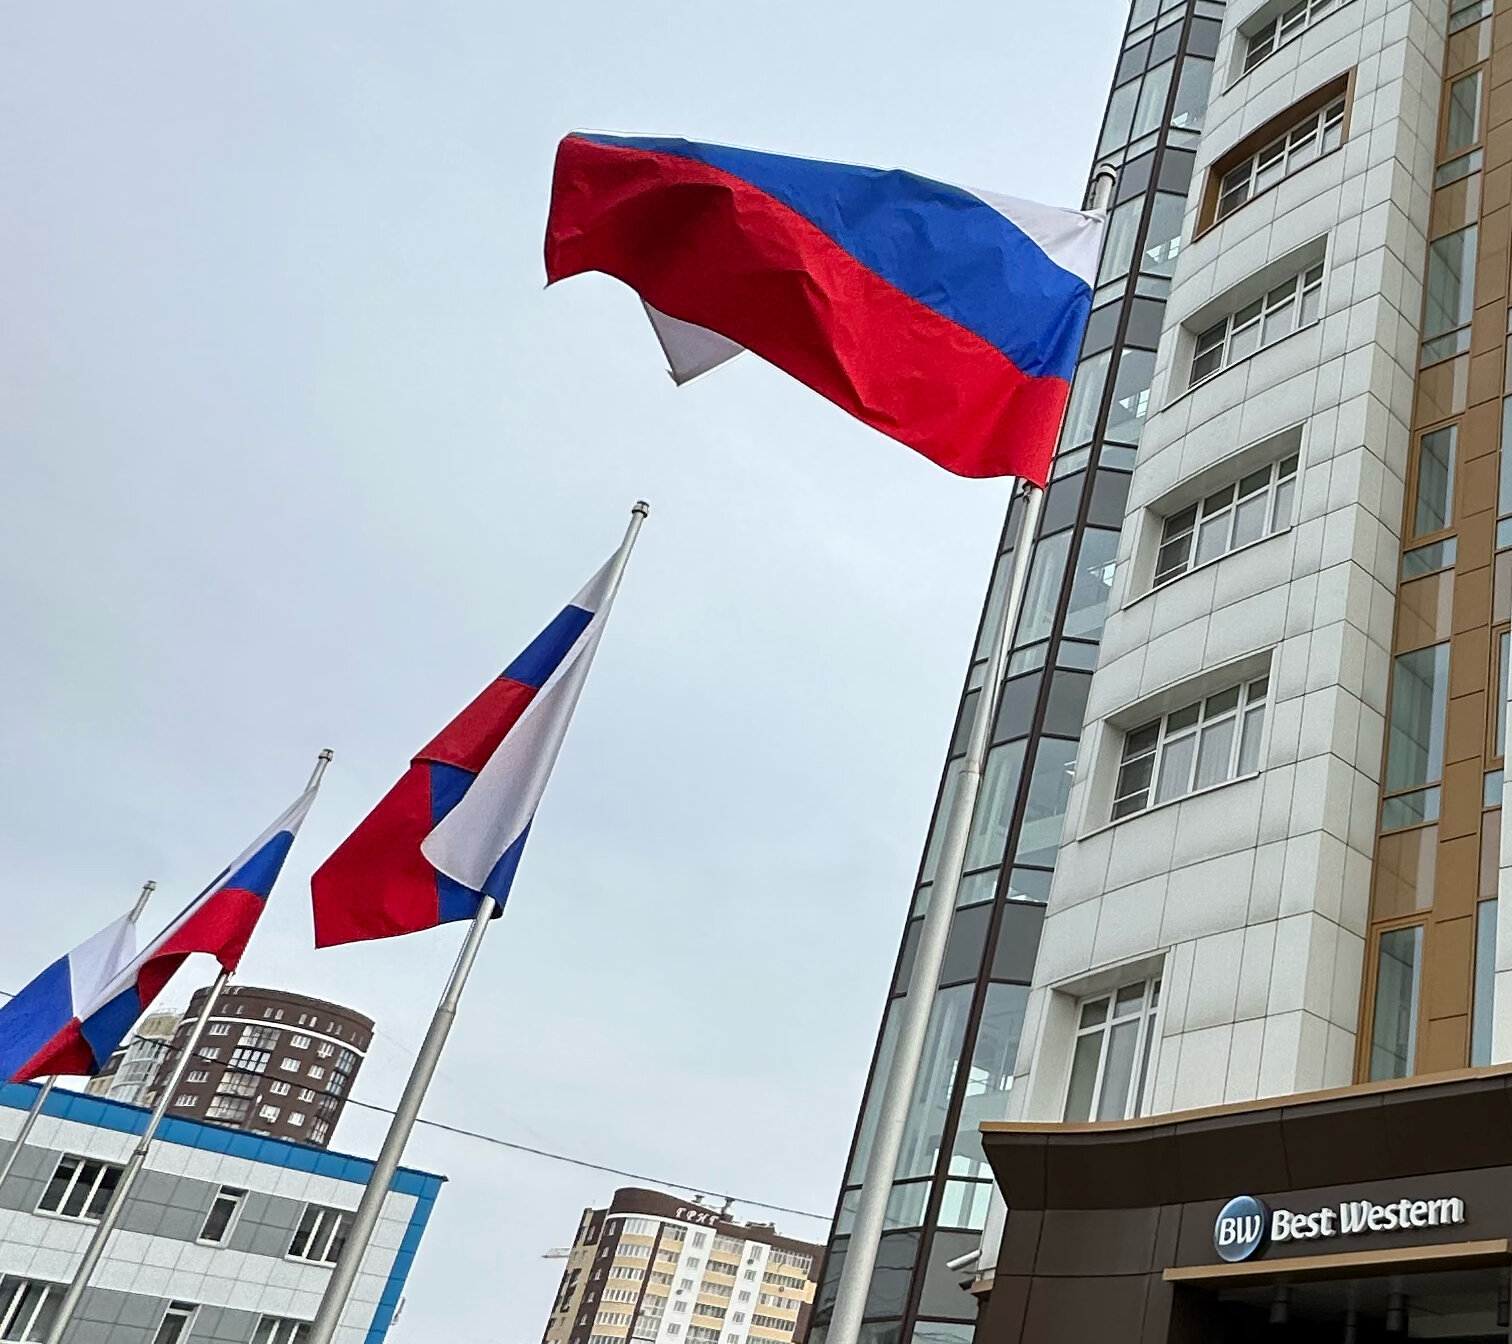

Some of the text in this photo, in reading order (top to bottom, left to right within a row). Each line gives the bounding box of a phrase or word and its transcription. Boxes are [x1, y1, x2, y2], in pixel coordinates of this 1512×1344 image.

[1218, 1214, 1261, 1246] BW
[1270, 1196, 1465, 1242] Best Western
